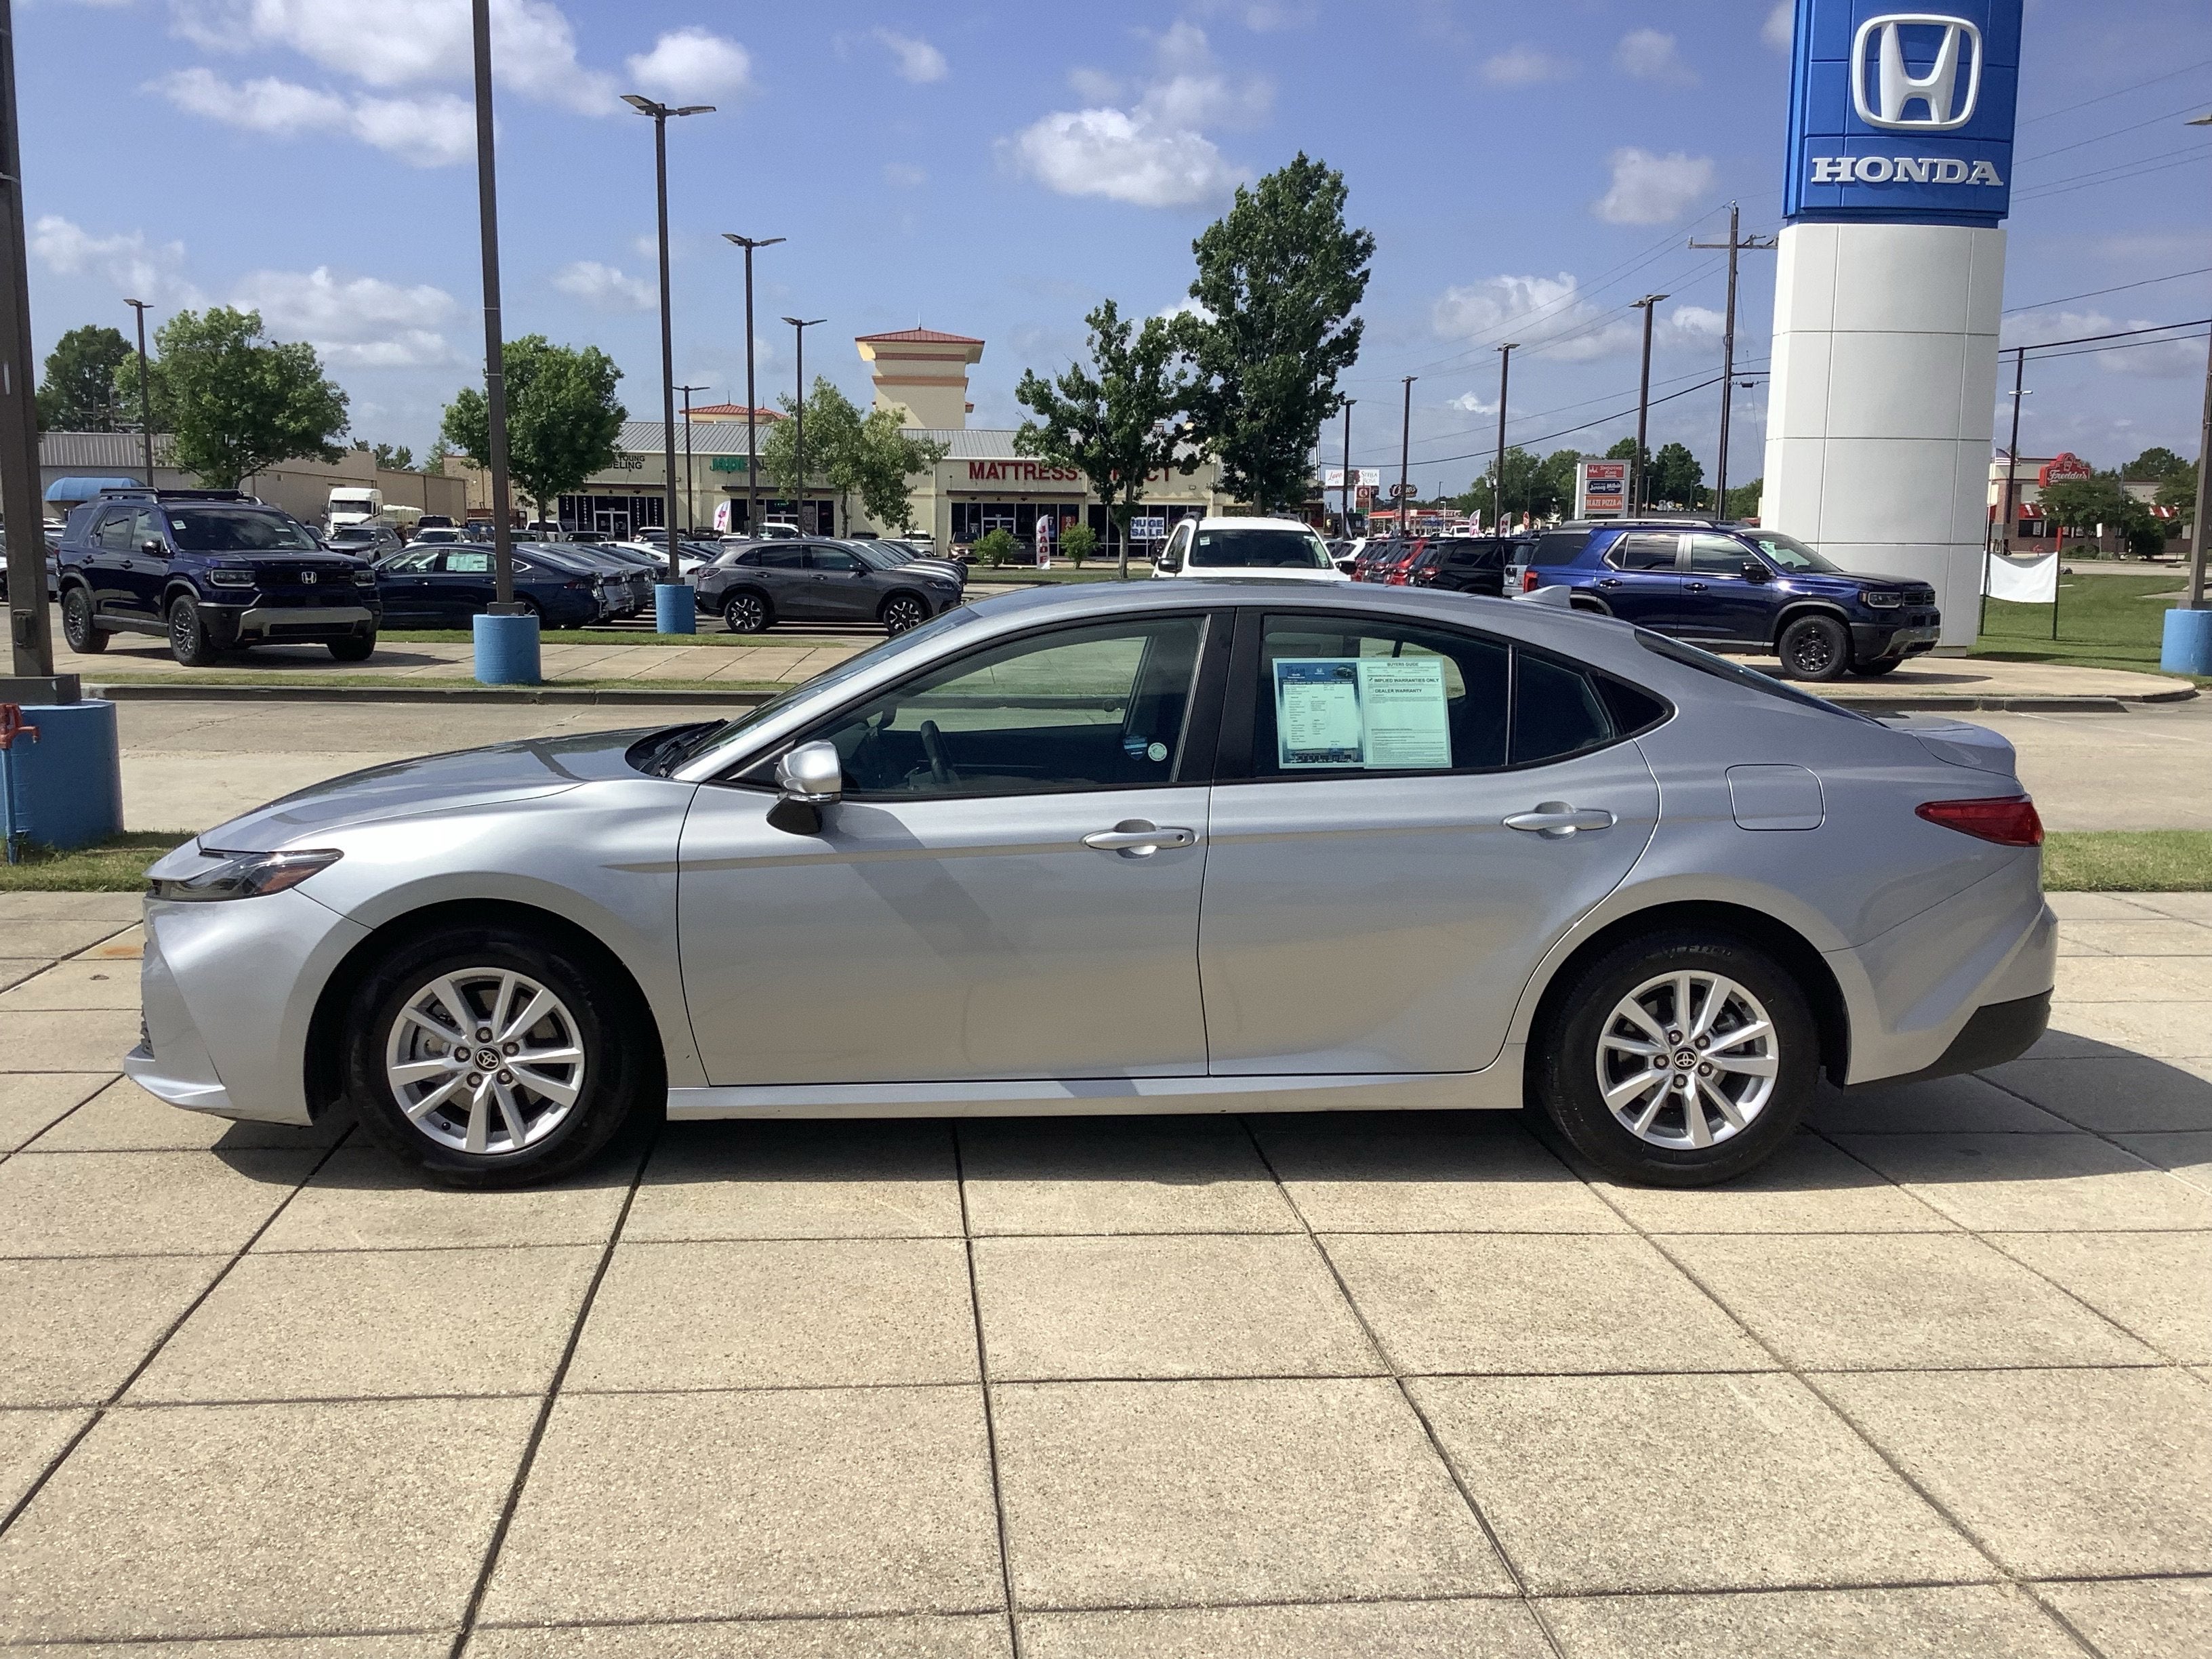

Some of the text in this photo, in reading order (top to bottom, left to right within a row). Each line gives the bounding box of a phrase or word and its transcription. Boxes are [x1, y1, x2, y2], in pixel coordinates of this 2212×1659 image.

[1810, 157, 2004, 187] HONDA
[968, 462, 1078, 481] MATTRESS
[1132, 518, 1164, 528] HUGE
[1132, 529, 1162, 537] SALE
[1038, 525, 1048, 564] JADE
